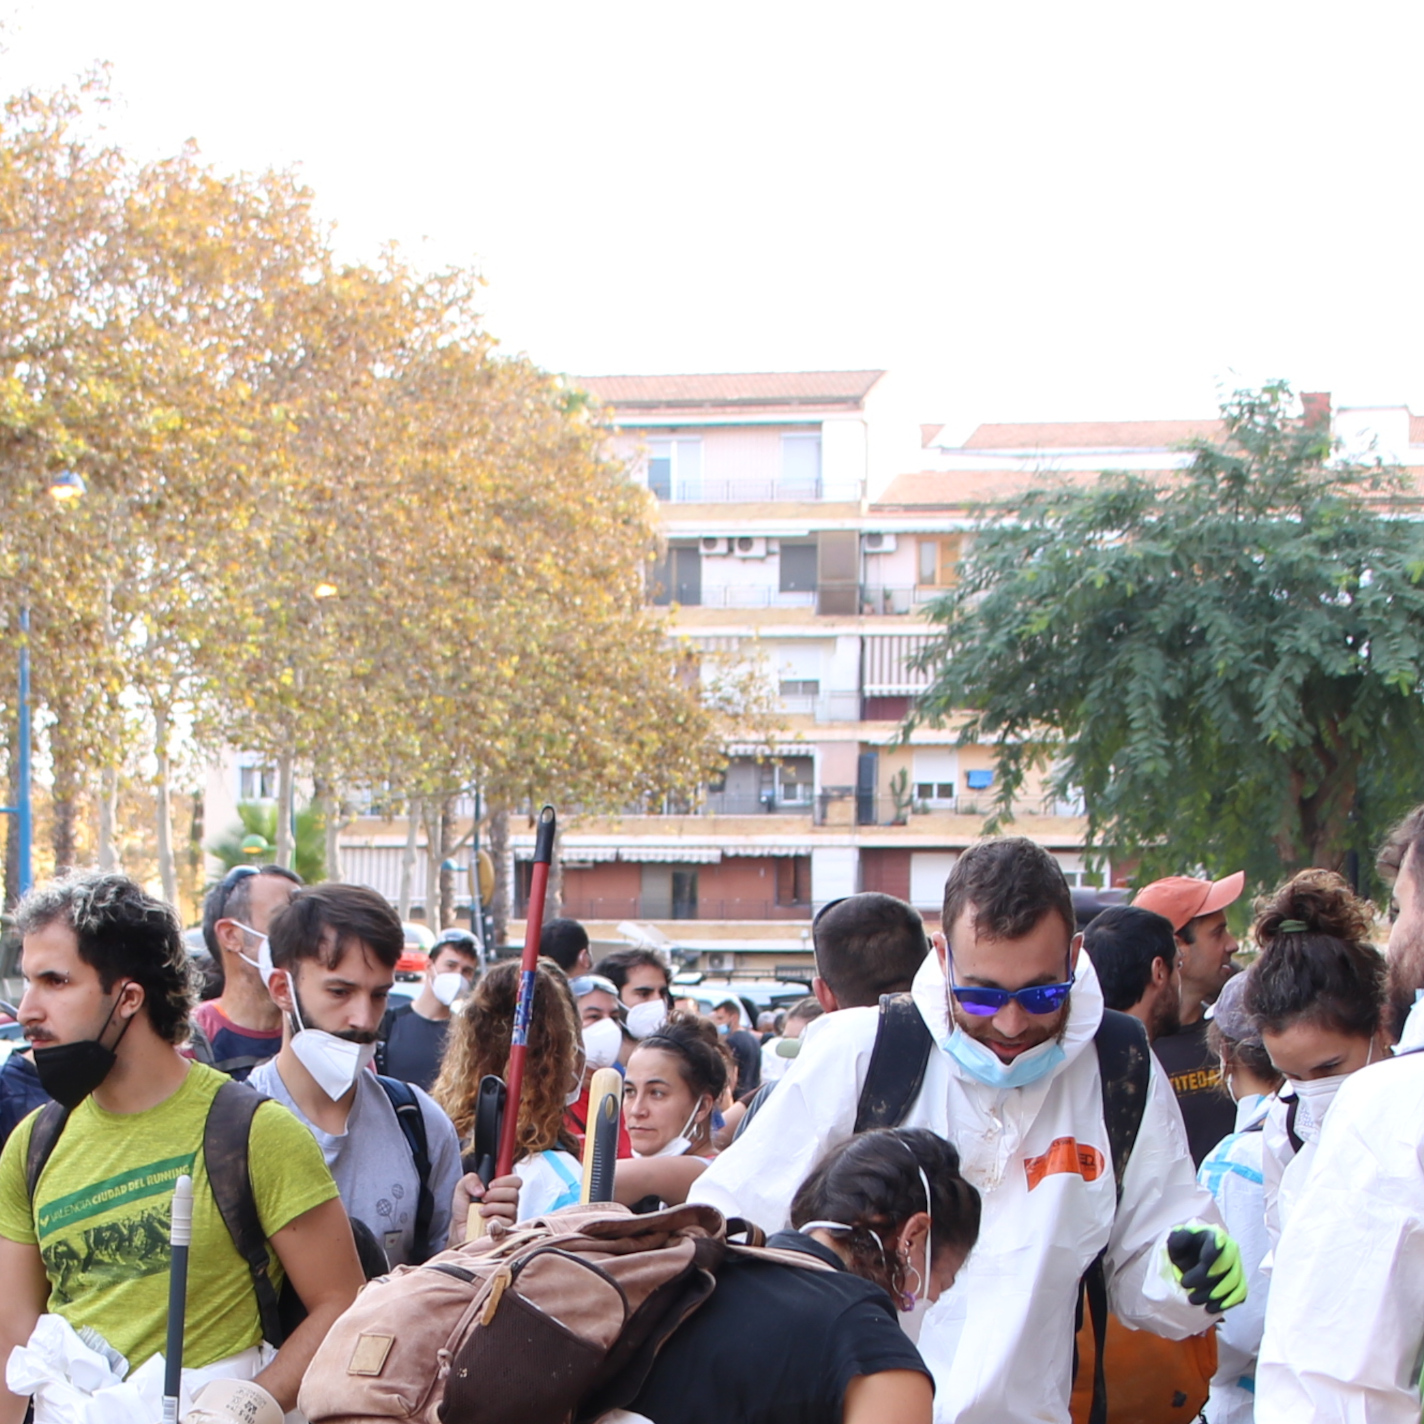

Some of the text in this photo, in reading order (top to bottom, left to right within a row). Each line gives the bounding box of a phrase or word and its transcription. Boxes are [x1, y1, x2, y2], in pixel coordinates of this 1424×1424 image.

[50, 1164, 191, 1222] VALENCIA CIUDAD DEL RUNNING
